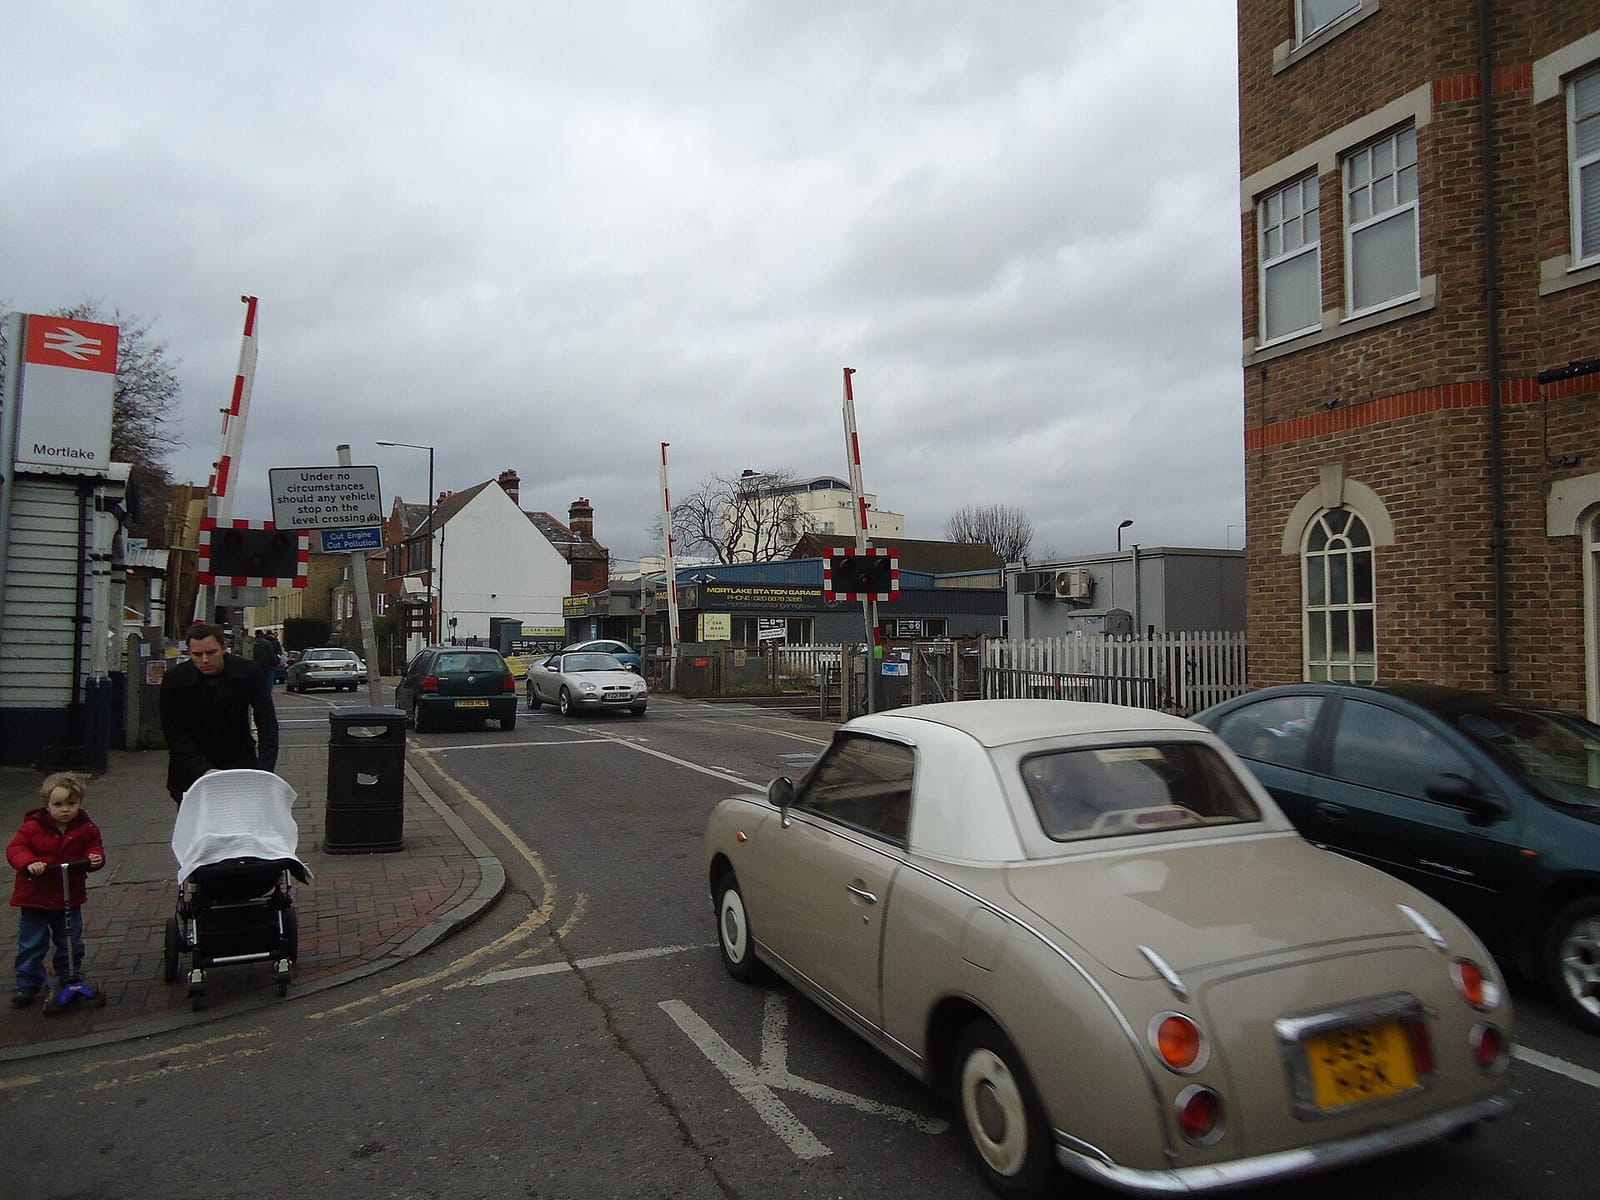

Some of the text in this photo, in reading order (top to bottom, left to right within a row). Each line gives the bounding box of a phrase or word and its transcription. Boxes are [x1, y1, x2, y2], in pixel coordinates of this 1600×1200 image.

[33, 443, 95, 460] Mortlake
[300, 472, 334, 481] Under
[287, 483, 364, 493] circumstances
[277, 492, 376, 504] should any vehicle
[297, 503, 359, 514] stop on the
[292, 514, 366, 525] level crossing
[347, 532, 372, 540] Engine
[327, 540, 377, 549] Cut Pollution
[706, 587, 752, 595] MORTLAKE
[753, 588, 788, 596] STATION
